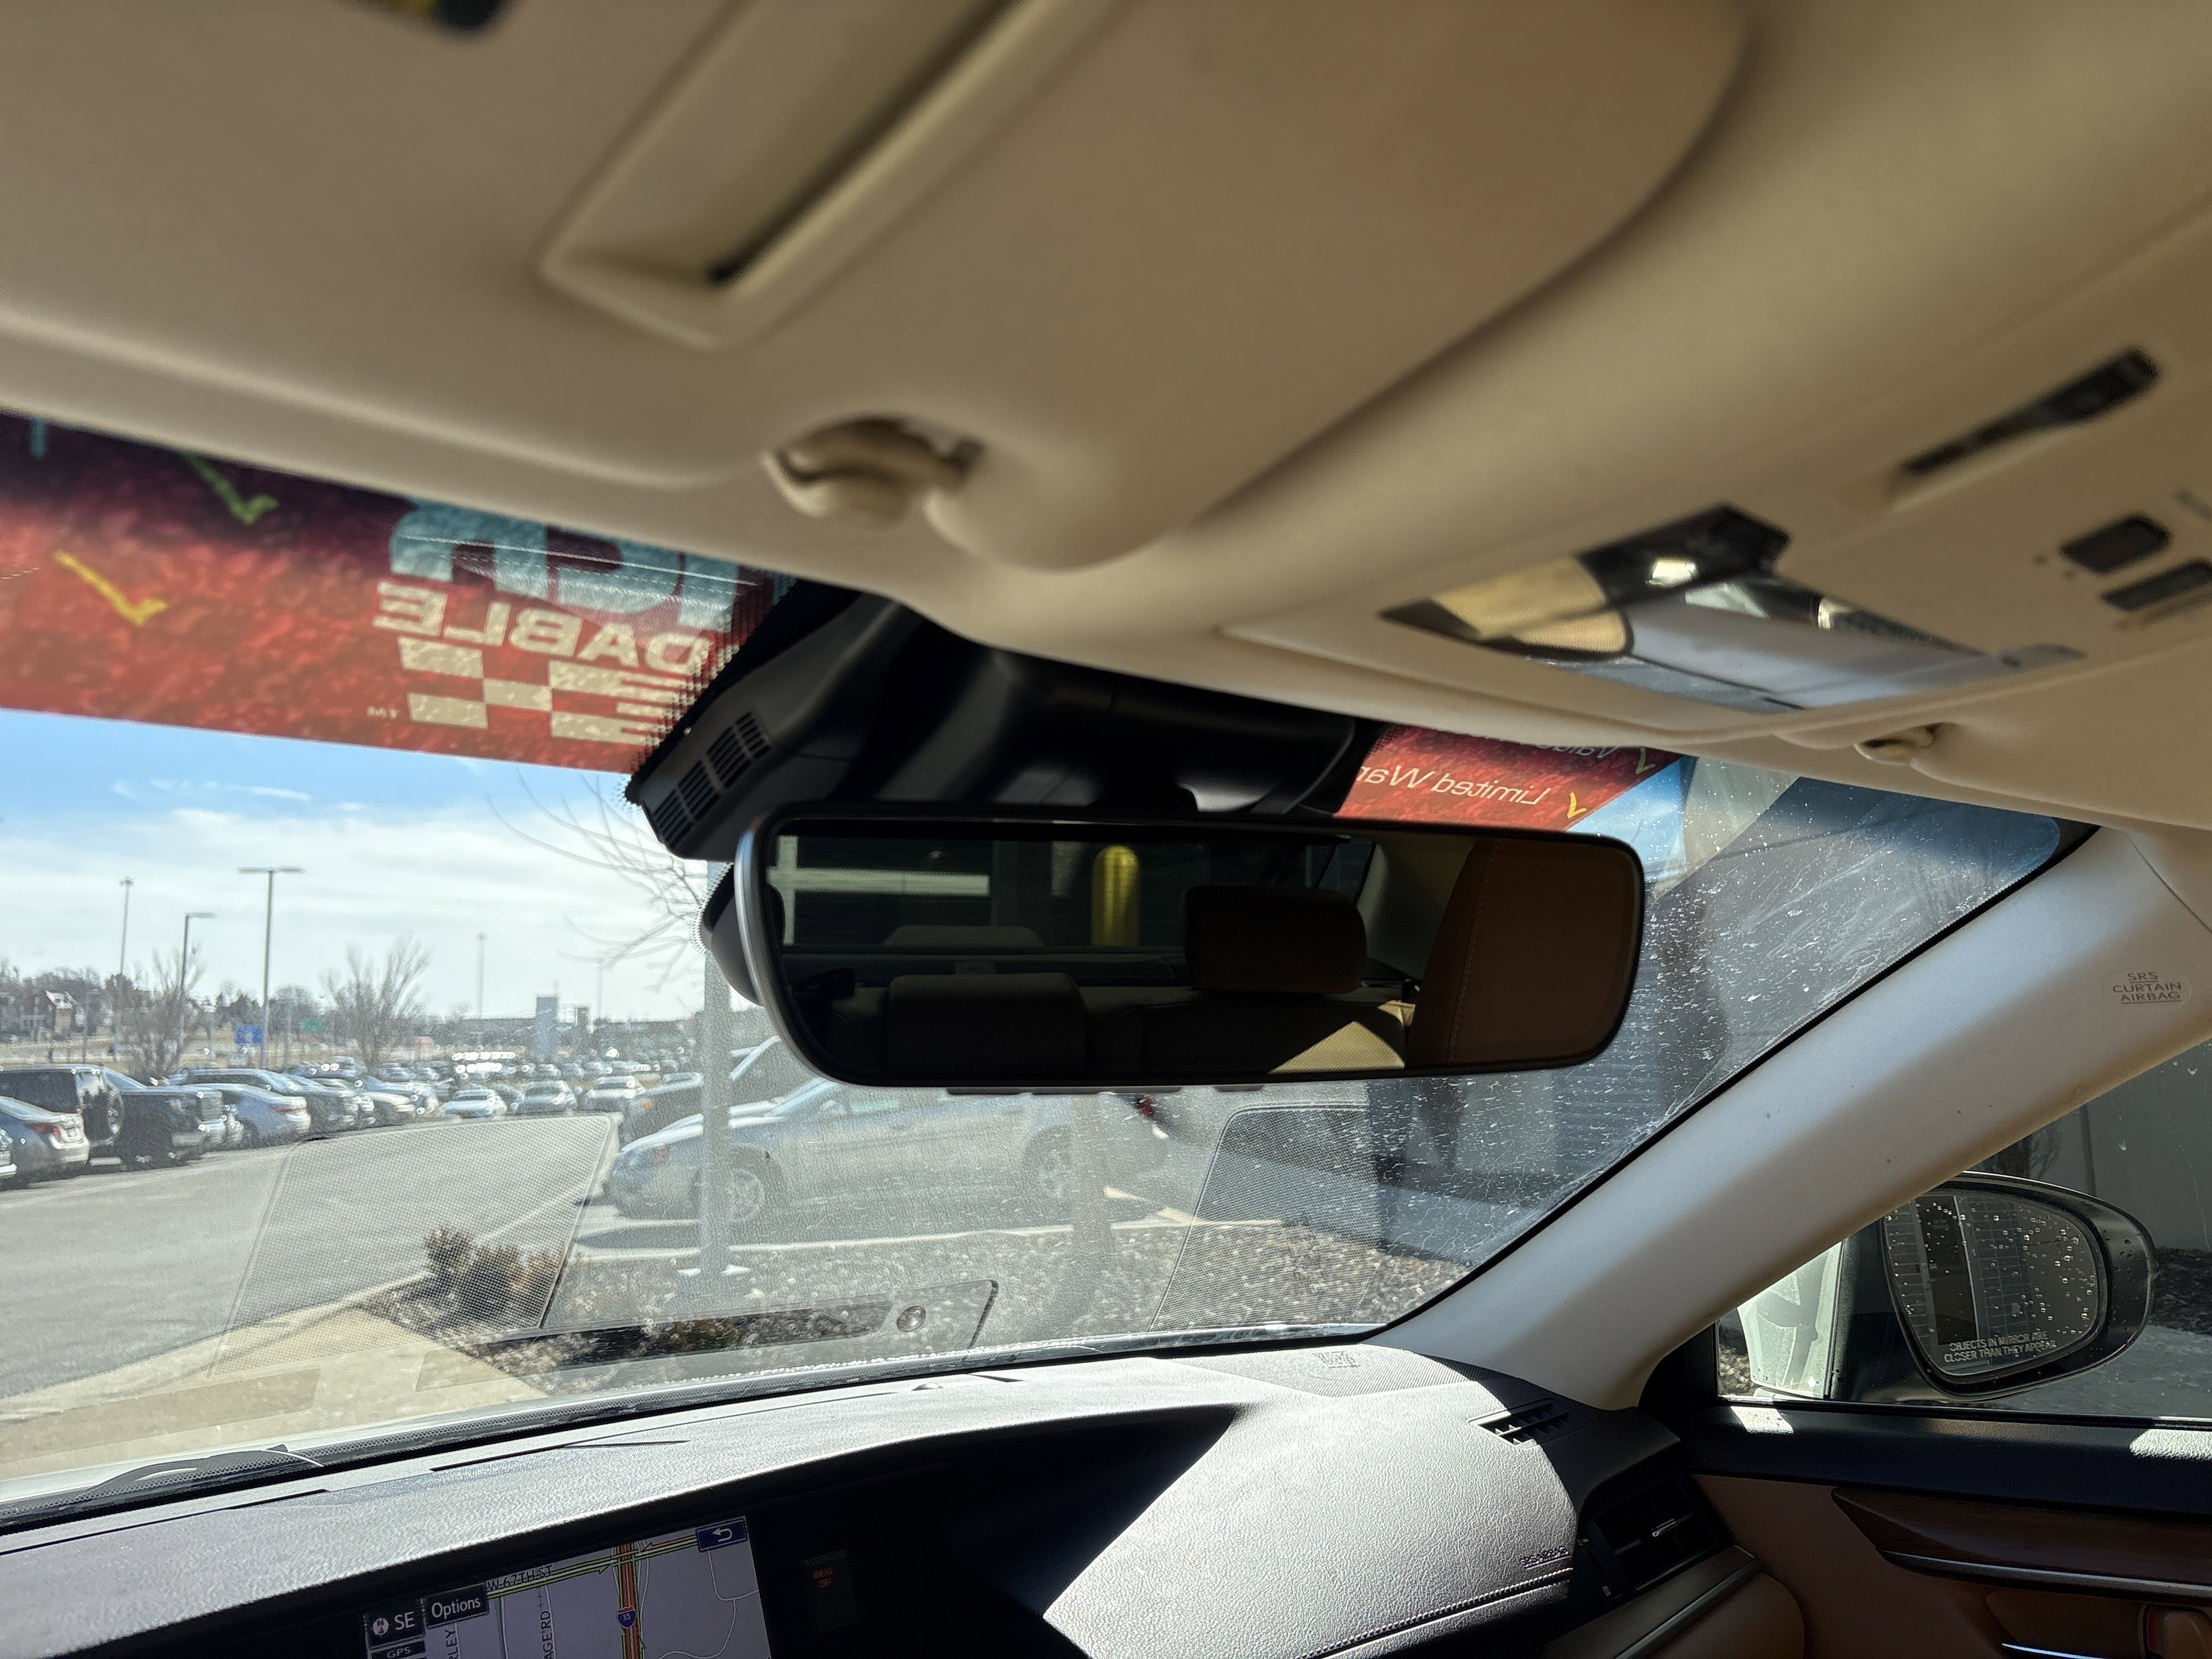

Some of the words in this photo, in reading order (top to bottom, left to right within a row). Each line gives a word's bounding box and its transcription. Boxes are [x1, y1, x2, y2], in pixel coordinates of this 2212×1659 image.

[2128, 972, 2158, 980] SRS
[2113, 982, 2181, 993] CURTAIN
[2121, 991, 2181, 1002] AIRBAG
[1949, 1339, 1987, 1352] OBJECTS
[1988, 1338, 1997, 1347] IN
[1998, 1333, 2030, 1346] MIRROR
[2031, 1330, 2049, 1341] ARE
[1944, 1350, 1978, 1363] CLOSER
[1978, 1347, 2002, 1358] THAN
[2002, 1345, 2024, 1355] THEY
[487, 1578, 499, 1592] W
[504, 1570, 535, 1588] 67TH
[538, 1565, 553, 1578] ST
[431, 1596, 481, 1620] Options
[622, 1612, 631, 1621] 35
[394, 1611, 415, 1630] SE
[539, 1611, 552, 1628] RD
[386, 1646, 411, 1658] GPS
